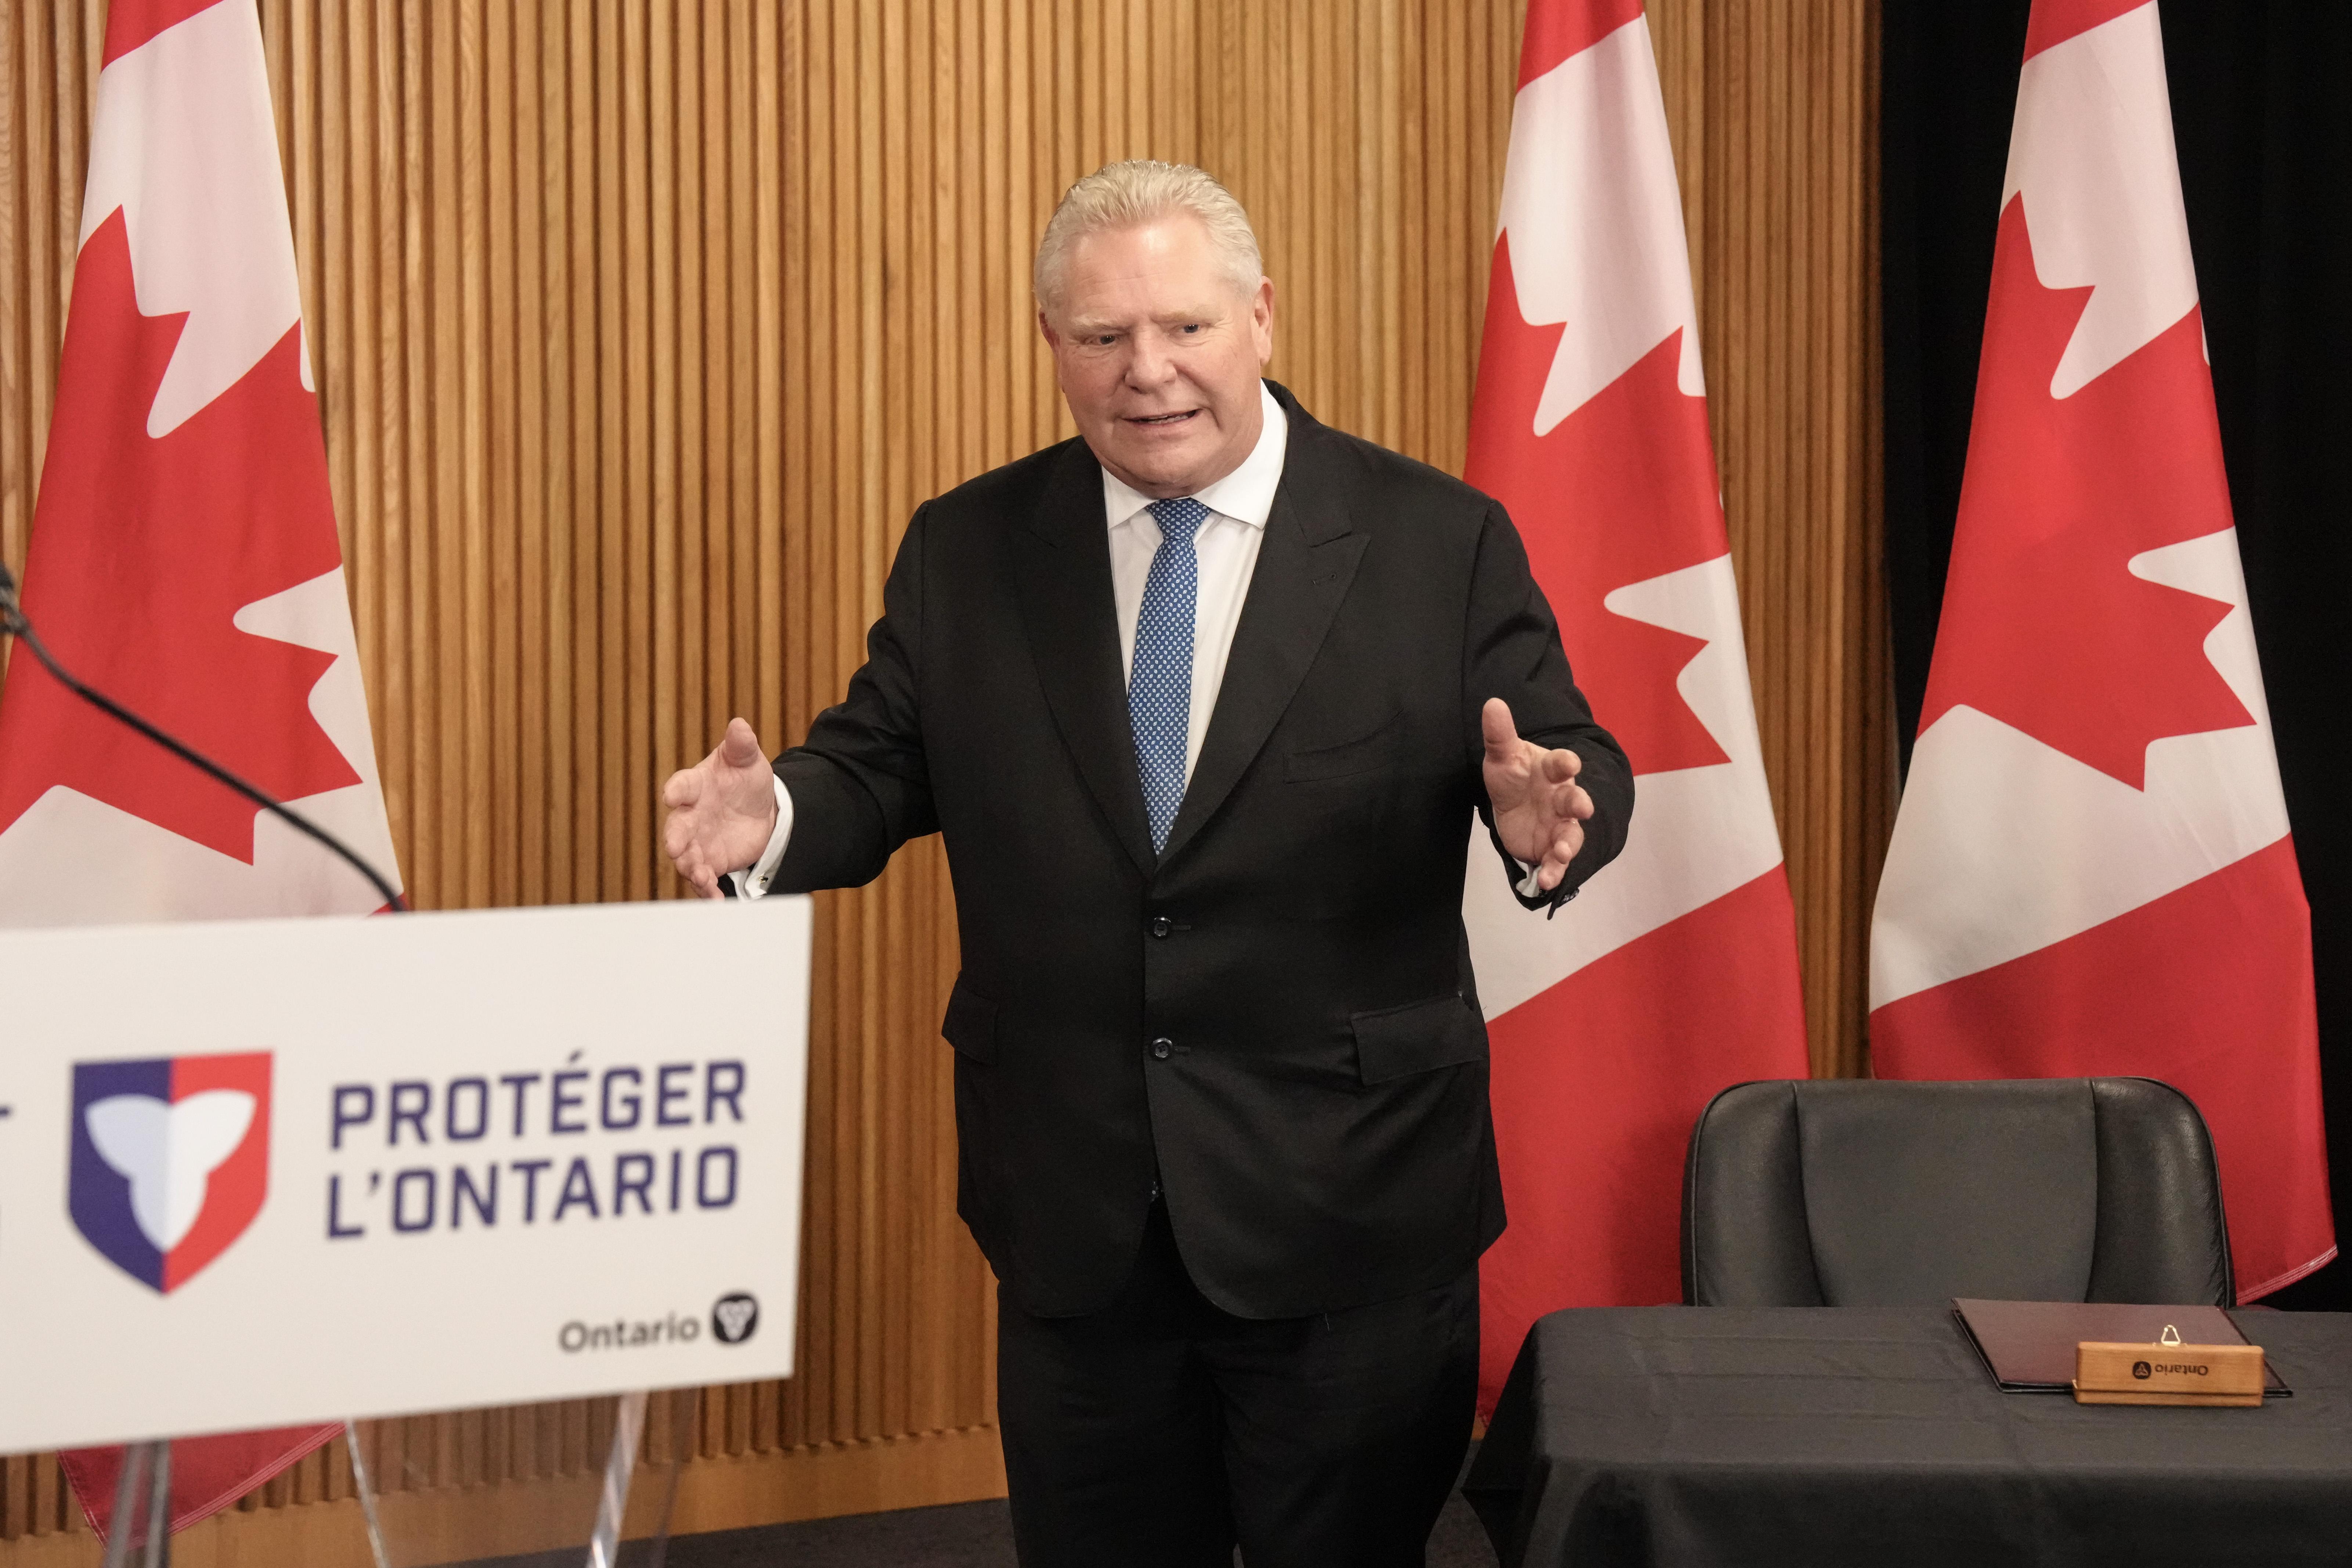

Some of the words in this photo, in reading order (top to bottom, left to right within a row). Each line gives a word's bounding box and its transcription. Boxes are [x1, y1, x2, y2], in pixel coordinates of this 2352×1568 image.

[330, 1049, 747, 1152] PROTÉGER
[325, 1144, 740, 1241] L'ONTARIO
[559, 1311, 700, 1353] Ontario
[2155, 1364, 2208, 1376] Ontario
